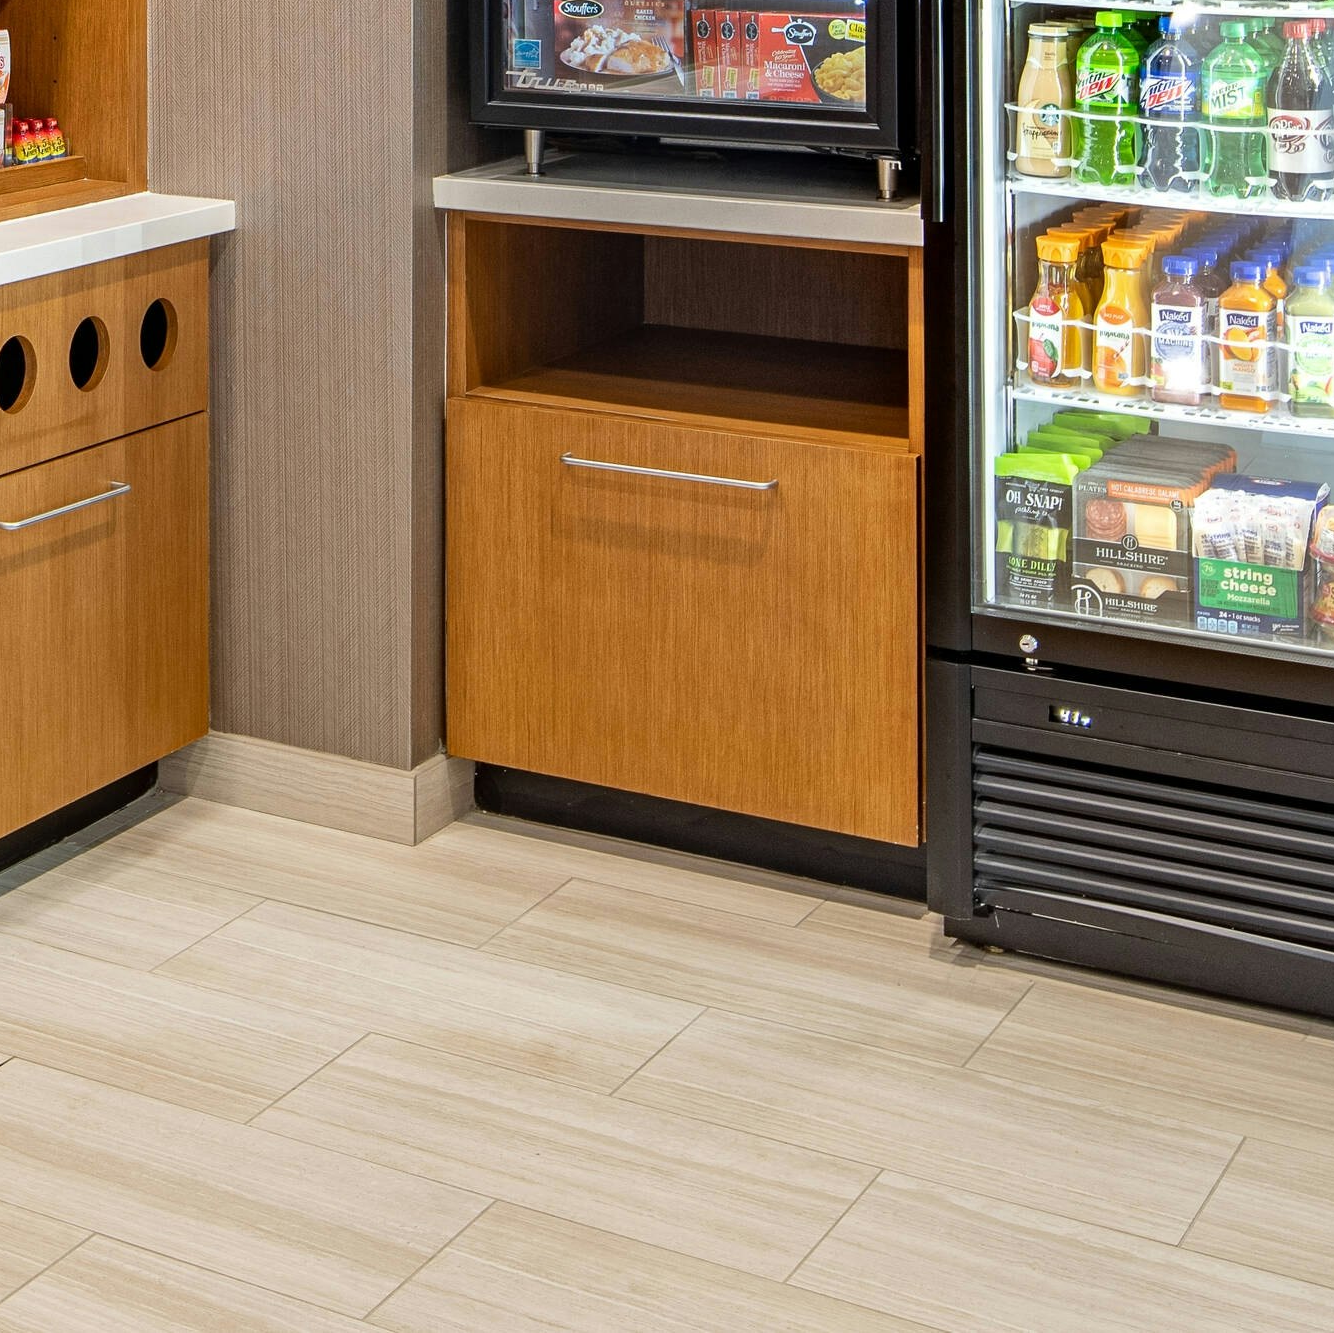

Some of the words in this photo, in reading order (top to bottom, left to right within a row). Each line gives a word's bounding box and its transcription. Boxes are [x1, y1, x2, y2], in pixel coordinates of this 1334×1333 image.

[563, 1, 599, 16] Stouffer's
[763, 61, 805, 71] Macaroni
[1161, 310, 1192, 322] Naked
[1228, 316, 1257, 327] Naked
[1302, 323, 1332, 334] Naked
[1158, 337, 1194, 348] MACHINE
[1078, 484, 1107, 494] PLATES
[1006, 489, 1022, 505] OH
[1025, 491, 1063, 510] SNAP!
[1095, 546, 1167, 566] HILLSHIRE
[1223, 567, 1274, 584] string
[1220, 579, 1277, 597] cheese
[1104, 597, 1158, 614] HILLSHIRE
[1226, 592, 1271, 607] Mozzarella
